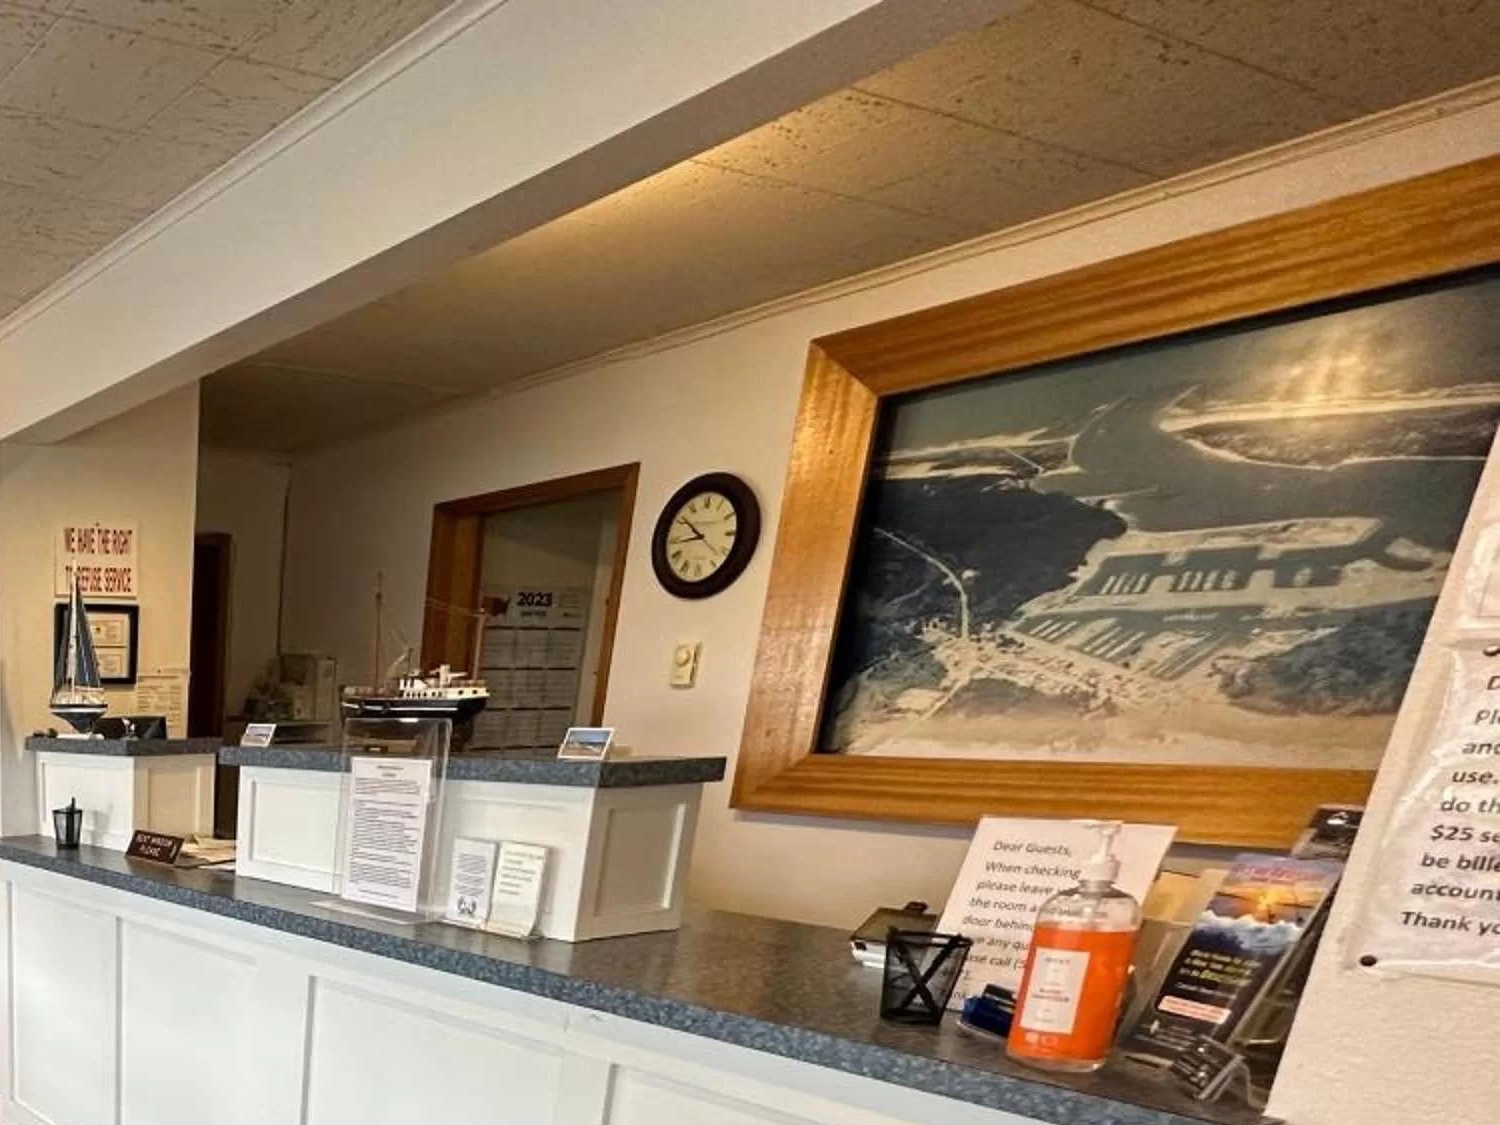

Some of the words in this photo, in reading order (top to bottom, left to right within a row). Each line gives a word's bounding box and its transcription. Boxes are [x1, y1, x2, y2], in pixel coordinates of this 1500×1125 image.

[105, 567, 131, 593] SERVICE
[517, 591, 553, 608] 2023
[1451, 770, 1499, 785] use.
[1441, 797, 1471, 812] do
[1430, 824, 1474, 842] $25
[993, 840, 1023, 852] Dear
[1026, 843, 1072, 857] Guests,
[1421, 852, 1450, 869] be
[985, 861, 1022, 874] When
[1024, 863, 1081, 880] checking
[976, 881, 1017, 893] please
[1019, 881, 1054, 895] leave
[970, 898, 990, 909] the
[993, 900, 1027, 912] room
[963, 915, 994, 926] door
[1401, 911, 1472, 932] Thank
[986, 937, 1010, 950] any
[990, 955, 1012, 968] call
